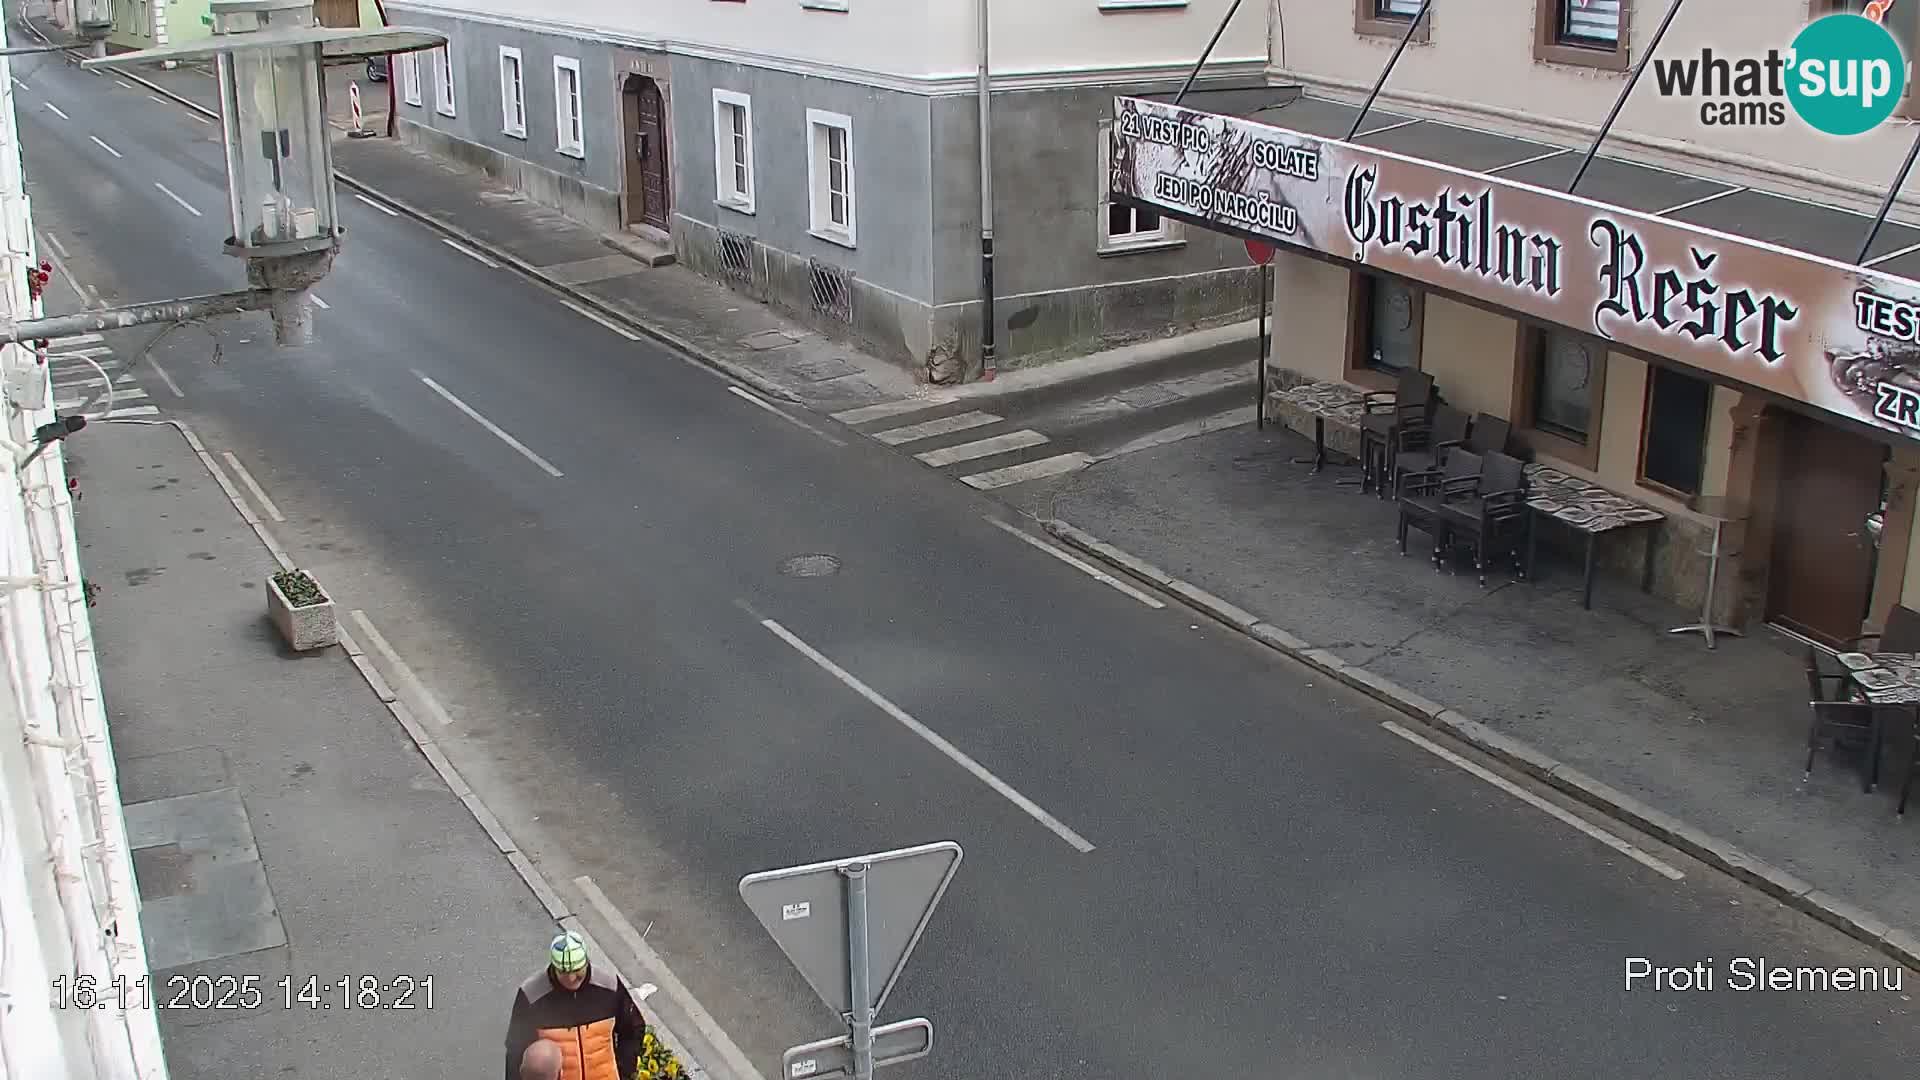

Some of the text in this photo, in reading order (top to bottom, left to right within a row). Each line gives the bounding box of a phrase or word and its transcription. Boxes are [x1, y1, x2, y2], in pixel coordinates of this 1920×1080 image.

[1122, 113, 1210, 151] 21 VRST PIC
[1254, 142, 1317, 179] SOLATE
[1155, 174, 1296, 232] JEDI PO NAROČILU
[1344, 163, 1799, 363] Gostilna Rešer
[1856, 292, 1920, 343] TES
